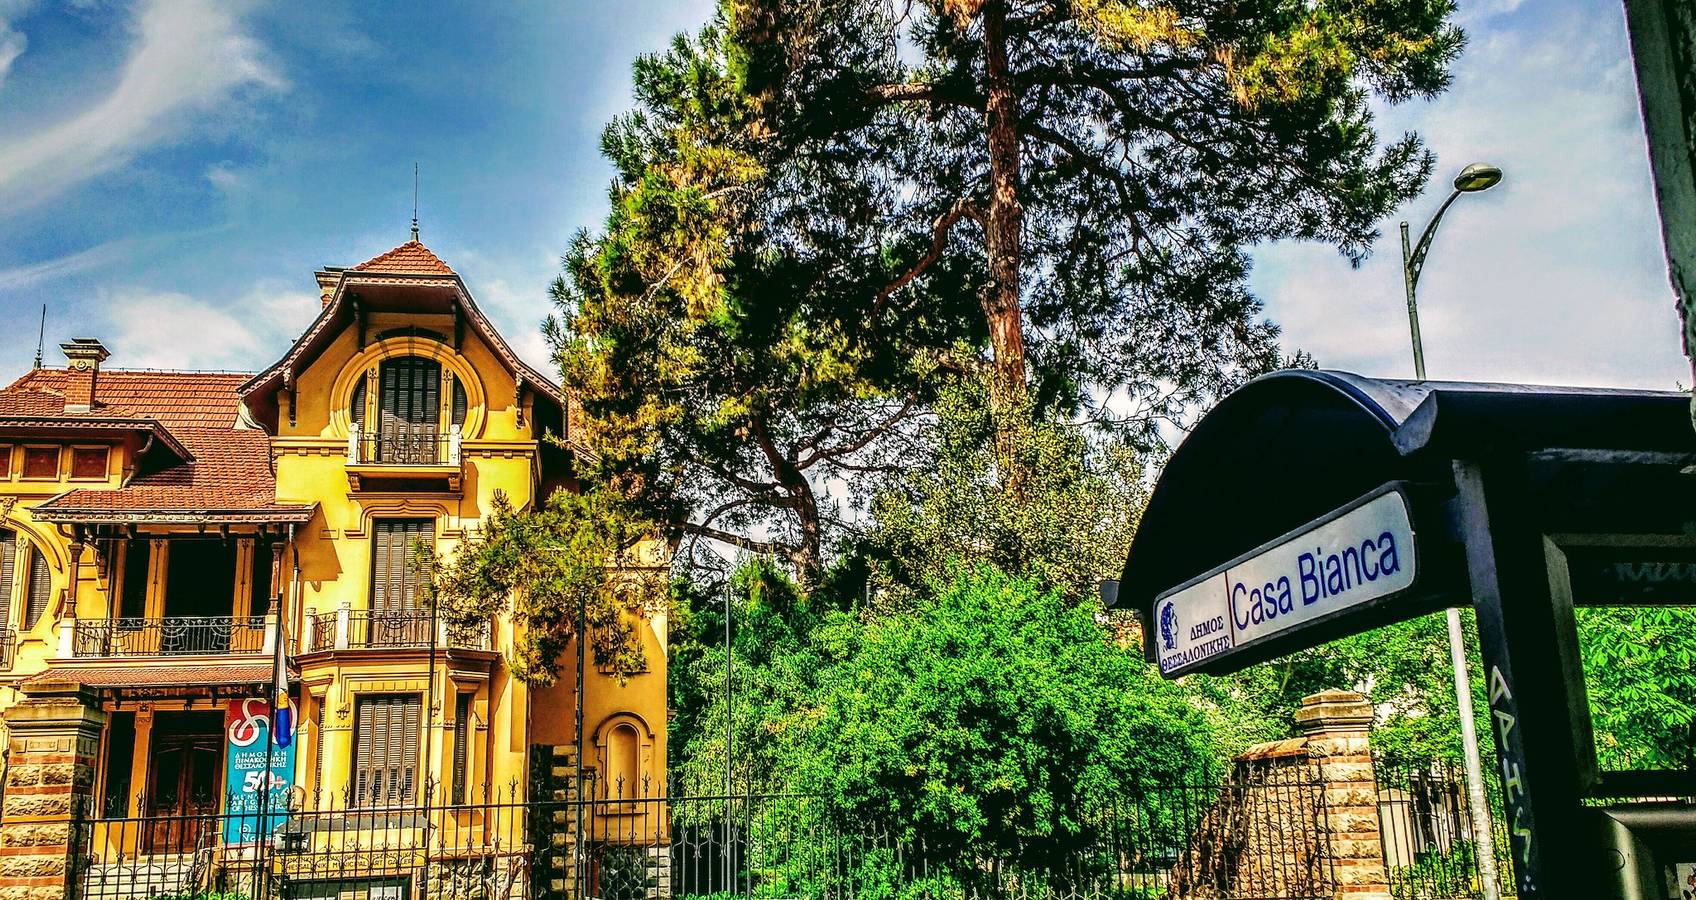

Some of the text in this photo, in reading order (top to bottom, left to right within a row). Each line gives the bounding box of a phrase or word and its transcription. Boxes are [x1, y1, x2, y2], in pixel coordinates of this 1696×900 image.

[1232, 531, 1400, 630] Casa Bianca
[1190, 615, 1224, 641] ΔΗΜΟΣ
[1161, 635, 1230, 672] ΘΕΣΣΑΛΟΝΙΚΗΣ
[235, 756, 287, 764] ΠΙΝΑΚΟΗΚΗ
